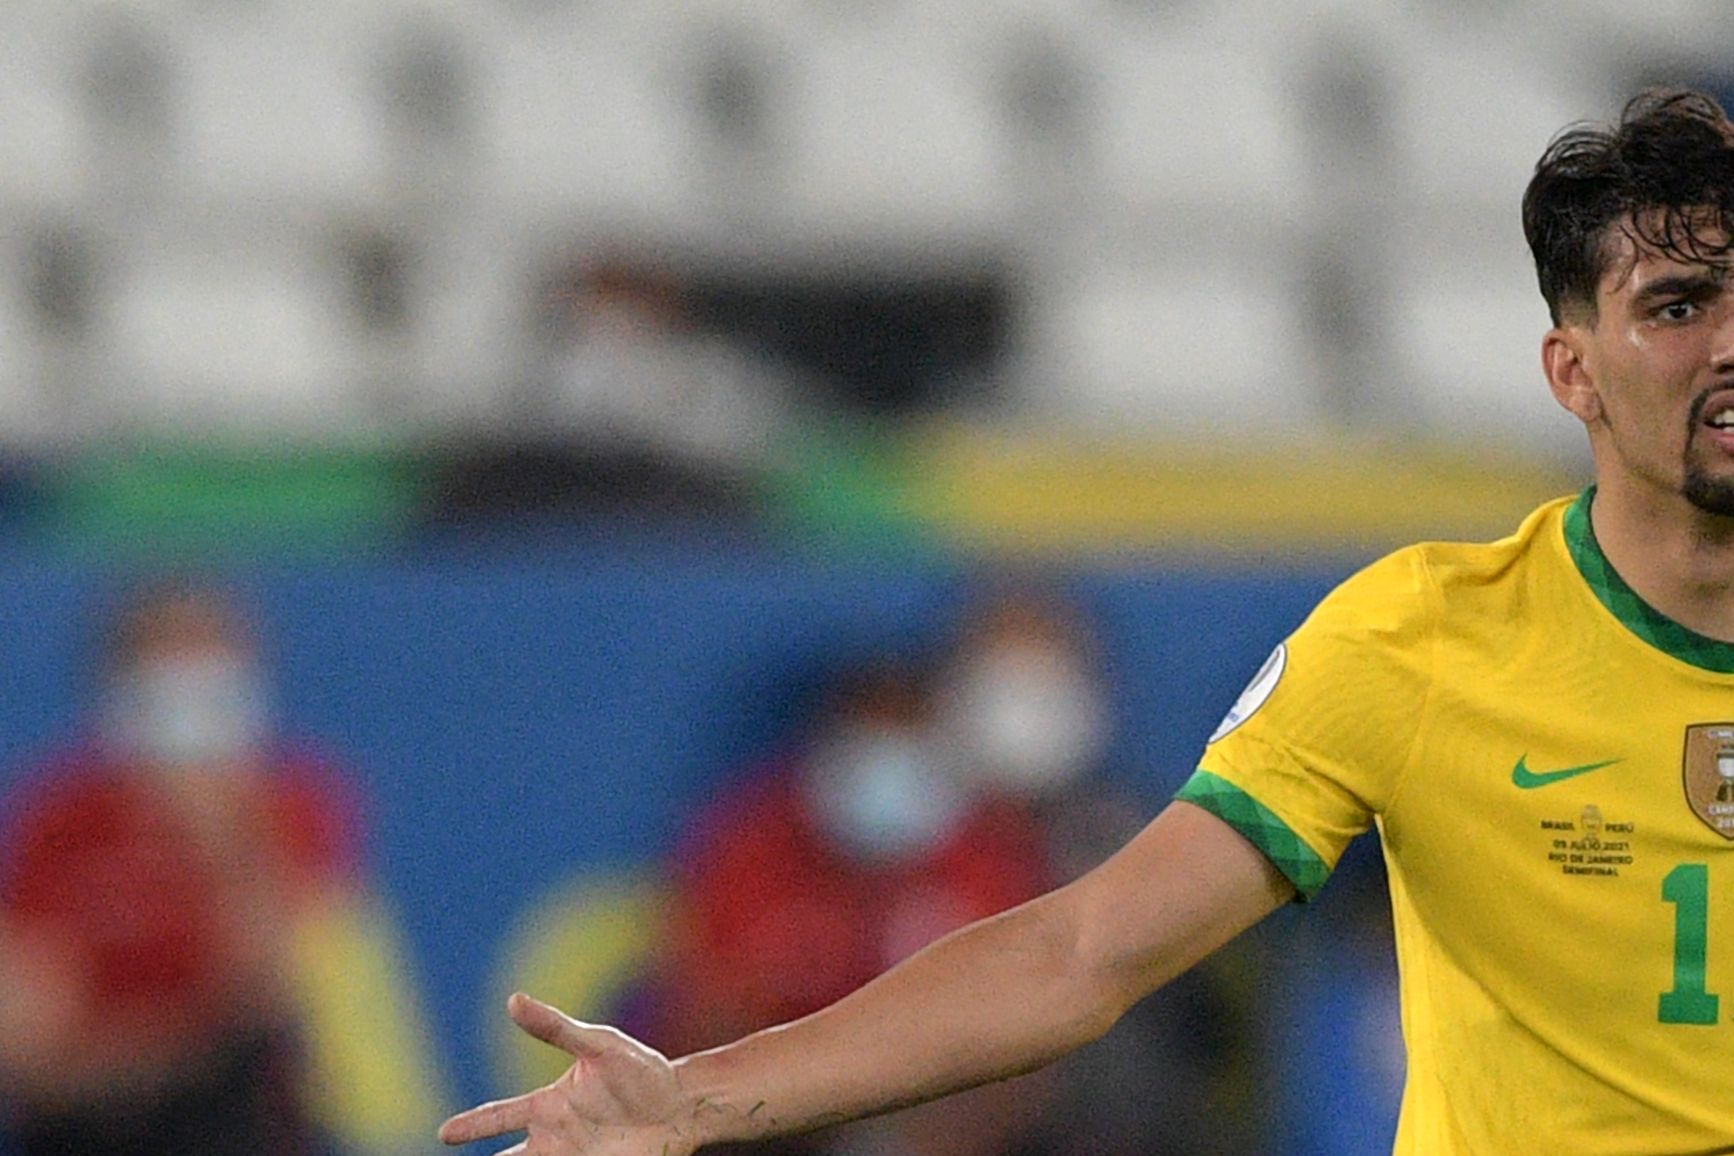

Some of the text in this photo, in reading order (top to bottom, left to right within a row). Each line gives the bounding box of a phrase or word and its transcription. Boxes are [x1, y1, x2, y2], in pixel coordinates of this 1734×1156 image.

[1541, 820, 1575, 831] BRASIL
[1603, 841, 1630, 851] 2021
[1548, 851, 1634, 865] RIO DE JANEIRO
[1563, 864, 1619, 877] SEMIFINAL
